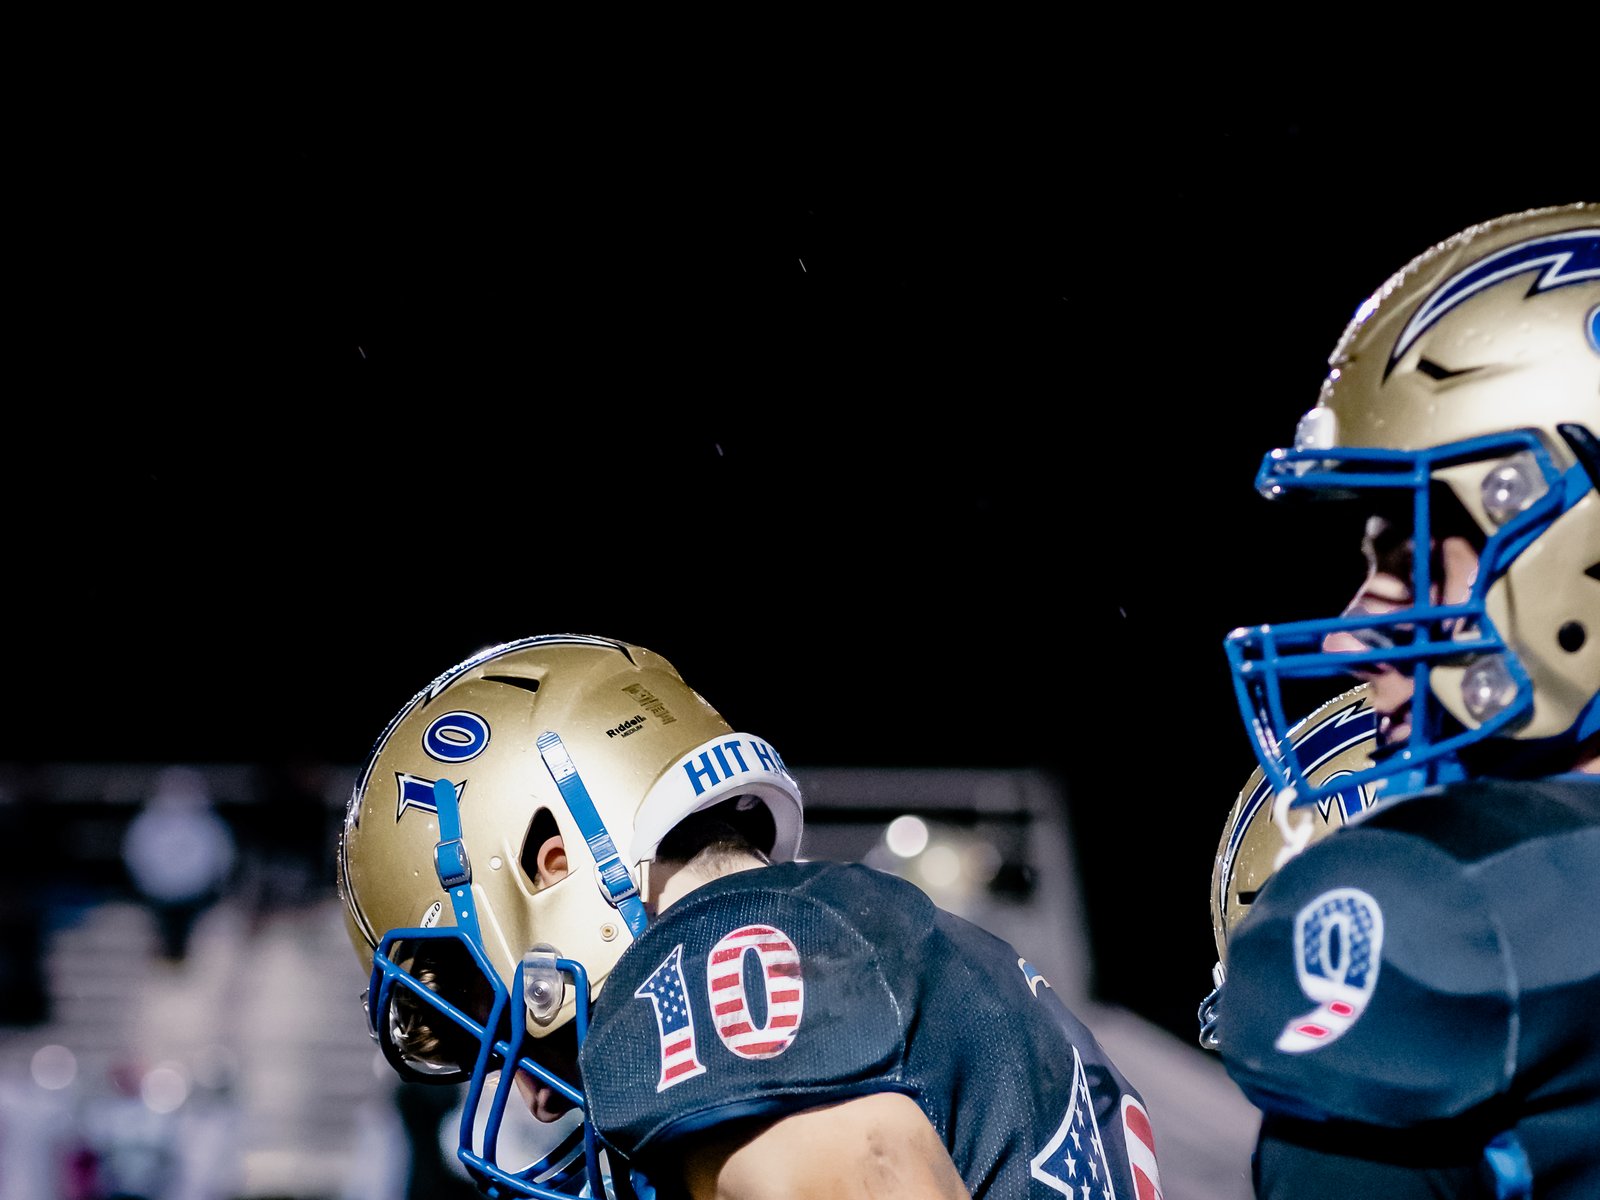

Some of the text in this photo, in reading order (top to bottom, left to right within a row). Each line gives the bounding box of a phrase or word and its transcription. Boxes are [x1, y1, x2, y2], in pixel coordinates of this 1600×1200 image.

[605, 714, 647, 738] Riddell
[621, 724, 644, 738] MEDIUM
[683, 740, 750, 797] HIT
[424, 902, 441, 928] PEED
[1274, 887, 1385, 1053] 9
[634, 923, 804, 1093] 10
